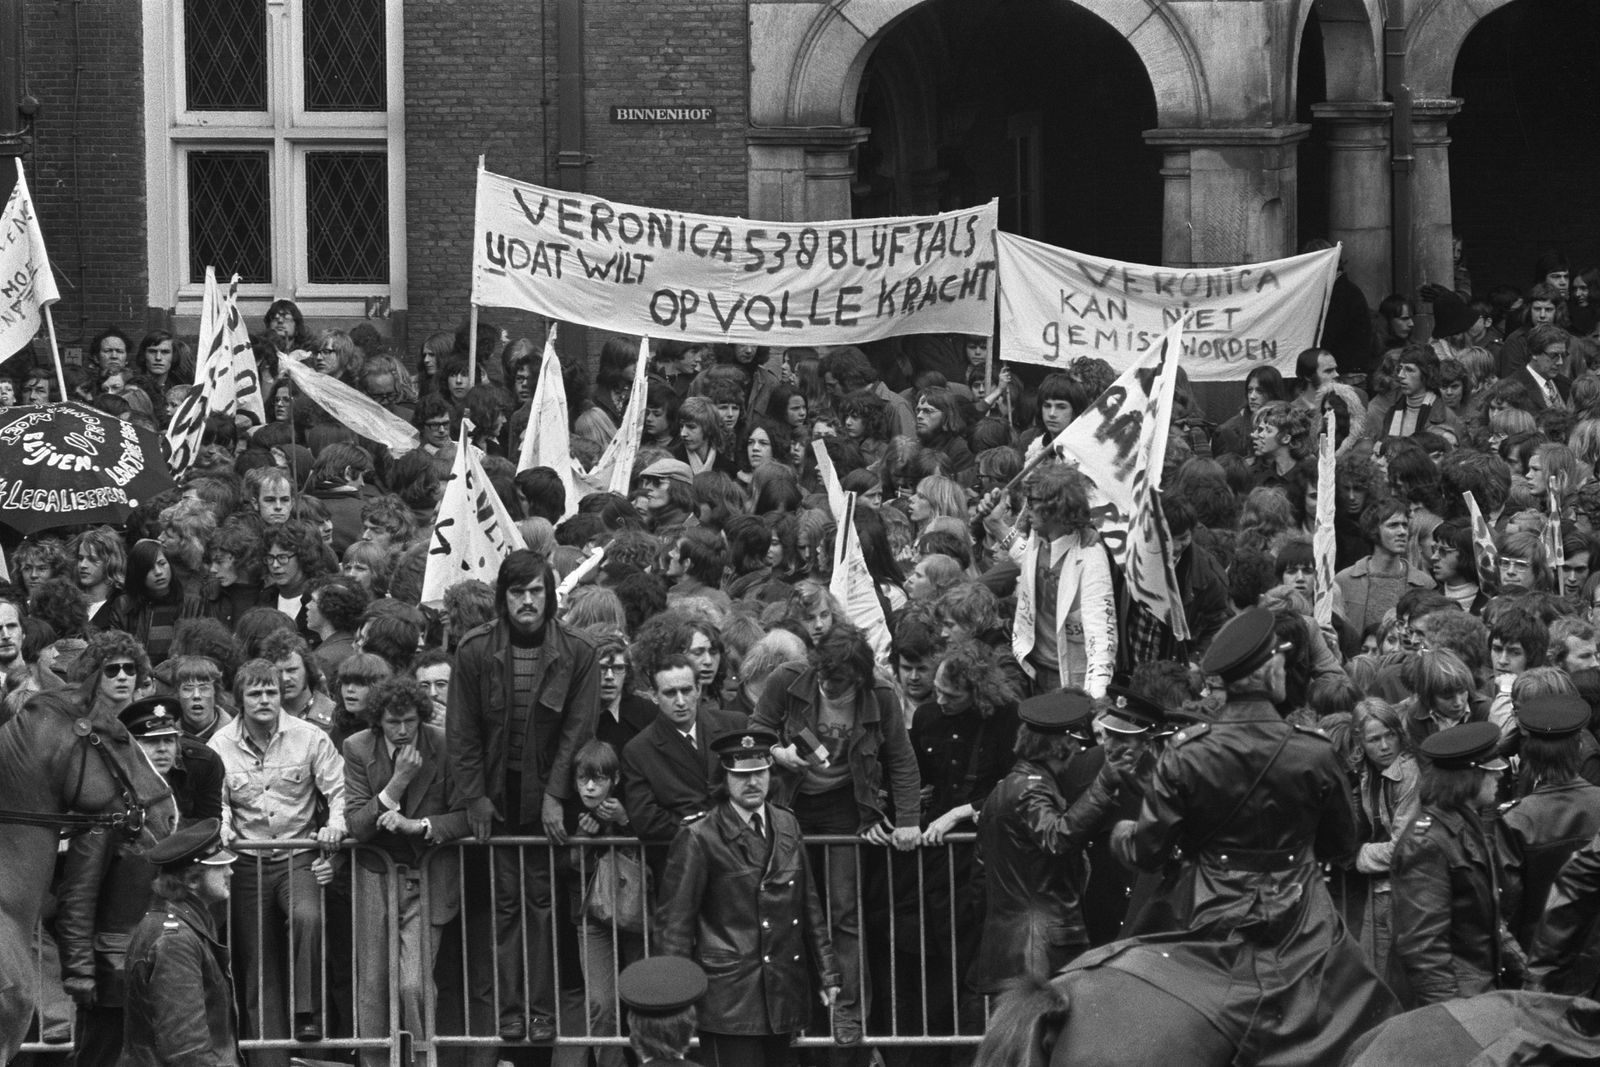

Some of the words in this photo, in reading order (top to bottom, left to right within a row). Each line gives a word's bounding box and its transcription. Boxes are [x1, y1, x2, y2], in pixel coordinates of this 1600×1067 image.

[616, 108, 712, 120] BINNENHOF
[744, 228, 819, 274] 538
[650, 288, 700, 331] OP
[707, 285, 863, 333] VOLLE
[876, 260, 996, 319] KRACHT
[1060, 289, 1128, 321] KAN
